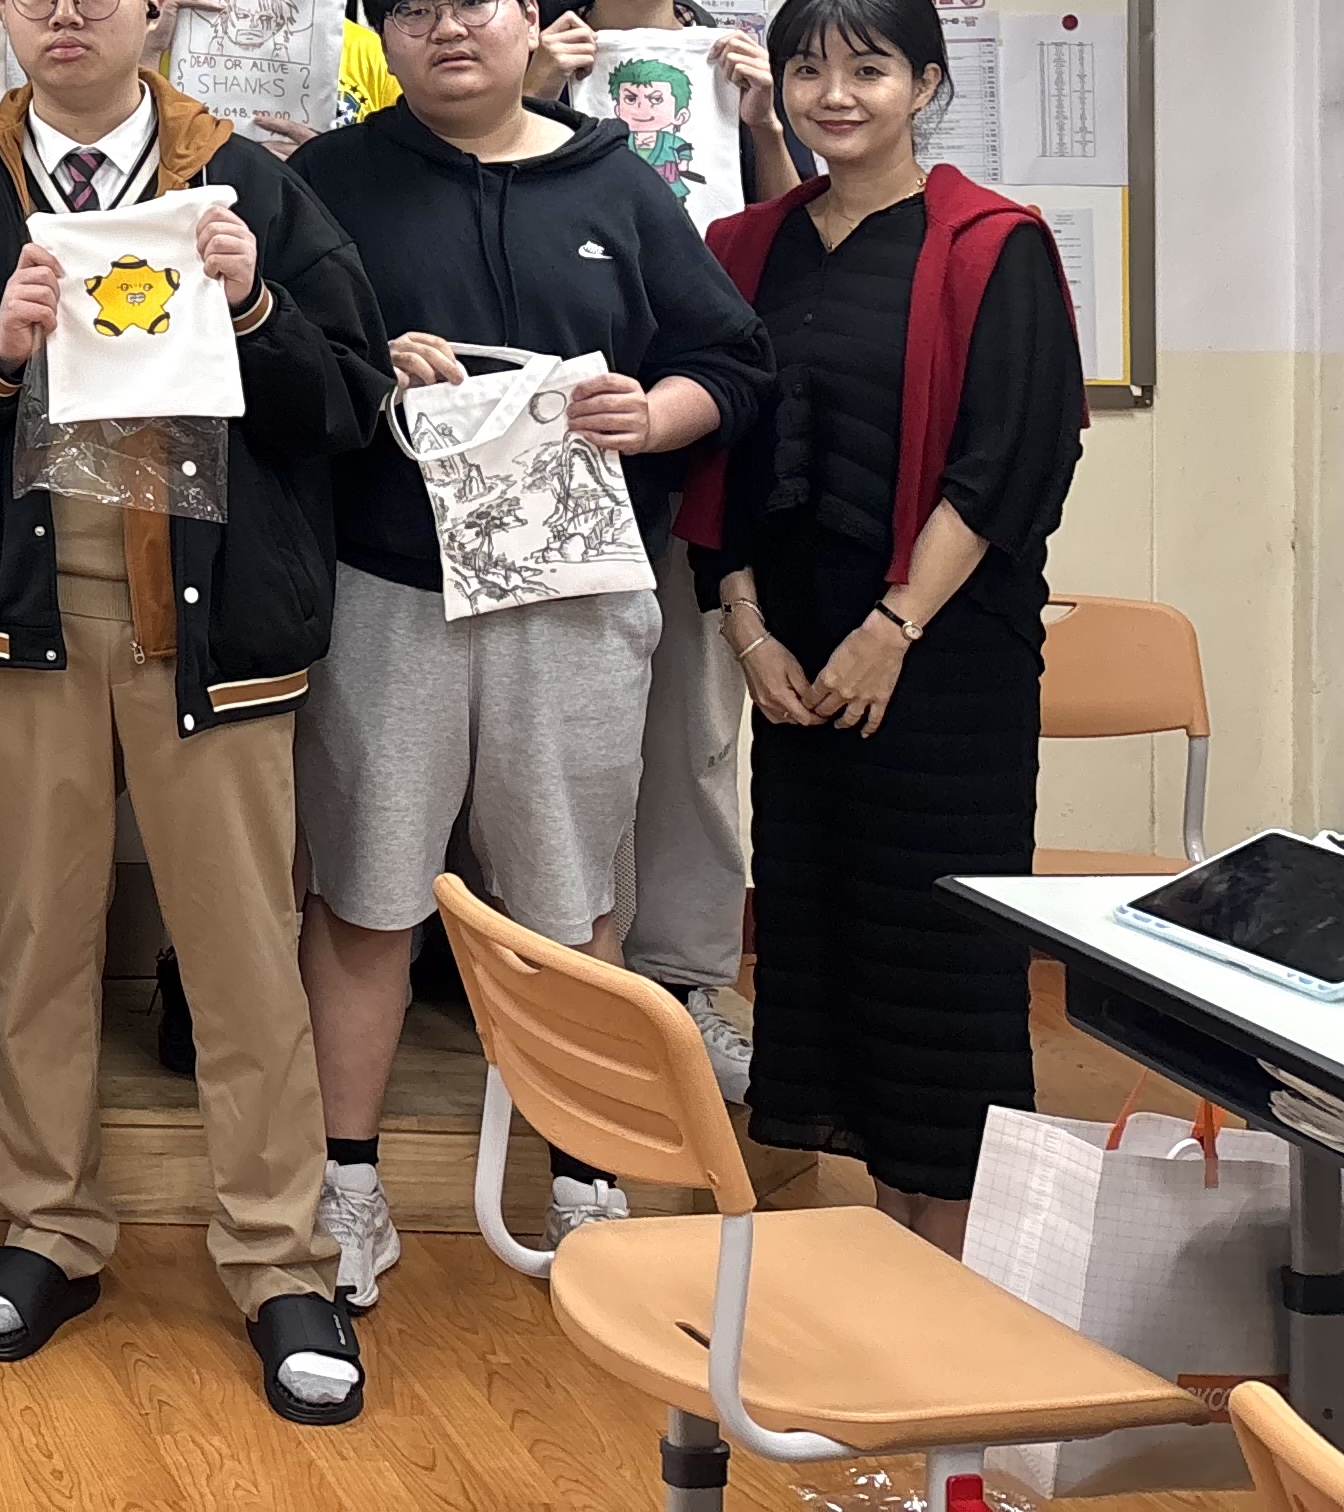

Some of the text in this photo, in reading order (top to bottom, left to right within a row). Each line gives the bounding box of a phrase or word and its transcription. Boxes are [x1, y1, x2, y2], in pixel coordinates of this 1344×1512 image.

[189, 55, 290, 75] DEAD OR ALIVE
[197, 73, 286, 98] SHANKS
